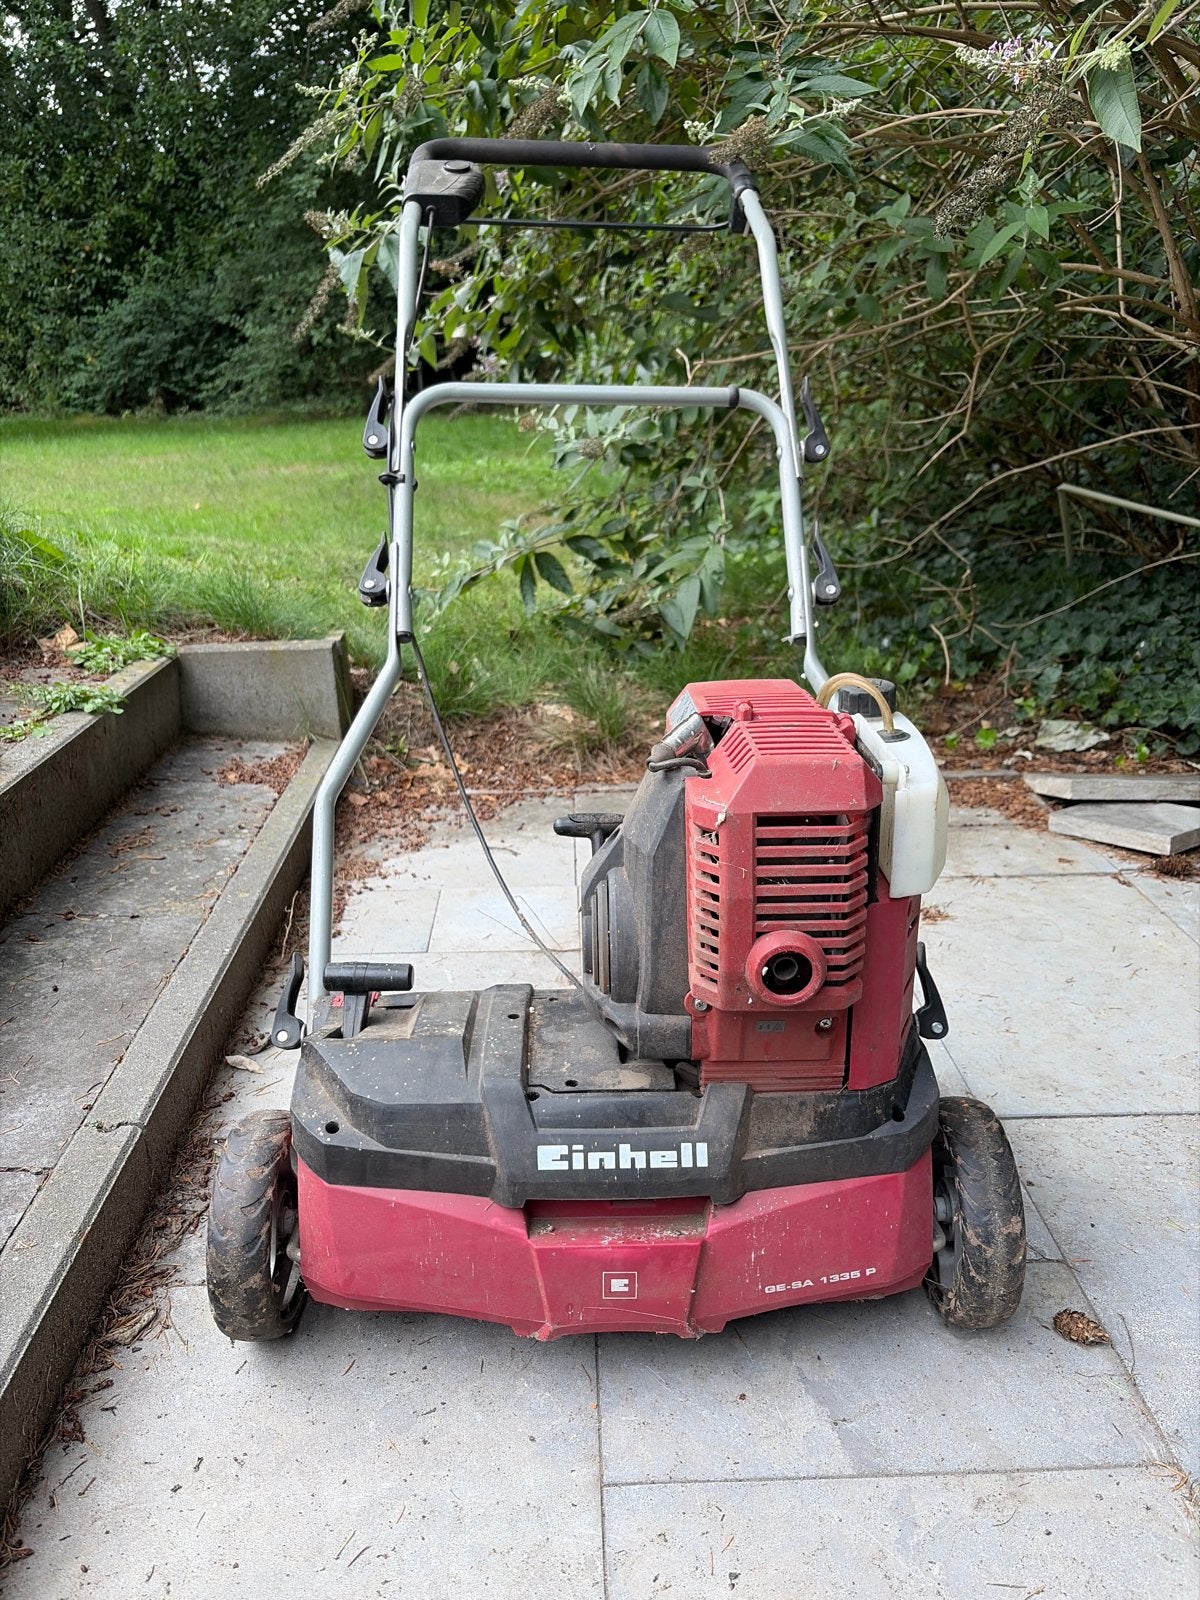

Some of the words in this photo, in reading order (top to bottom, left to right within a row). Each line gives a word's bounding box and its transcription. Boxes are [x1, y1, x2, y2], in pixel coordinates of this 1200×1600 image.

[537, 1142, 708, 1171] Einhell
[764, 1279, 814, 1294] GE-SA
[820, 1270, 861, 1284] 1335
[865, 1267, 877, 1276] P
